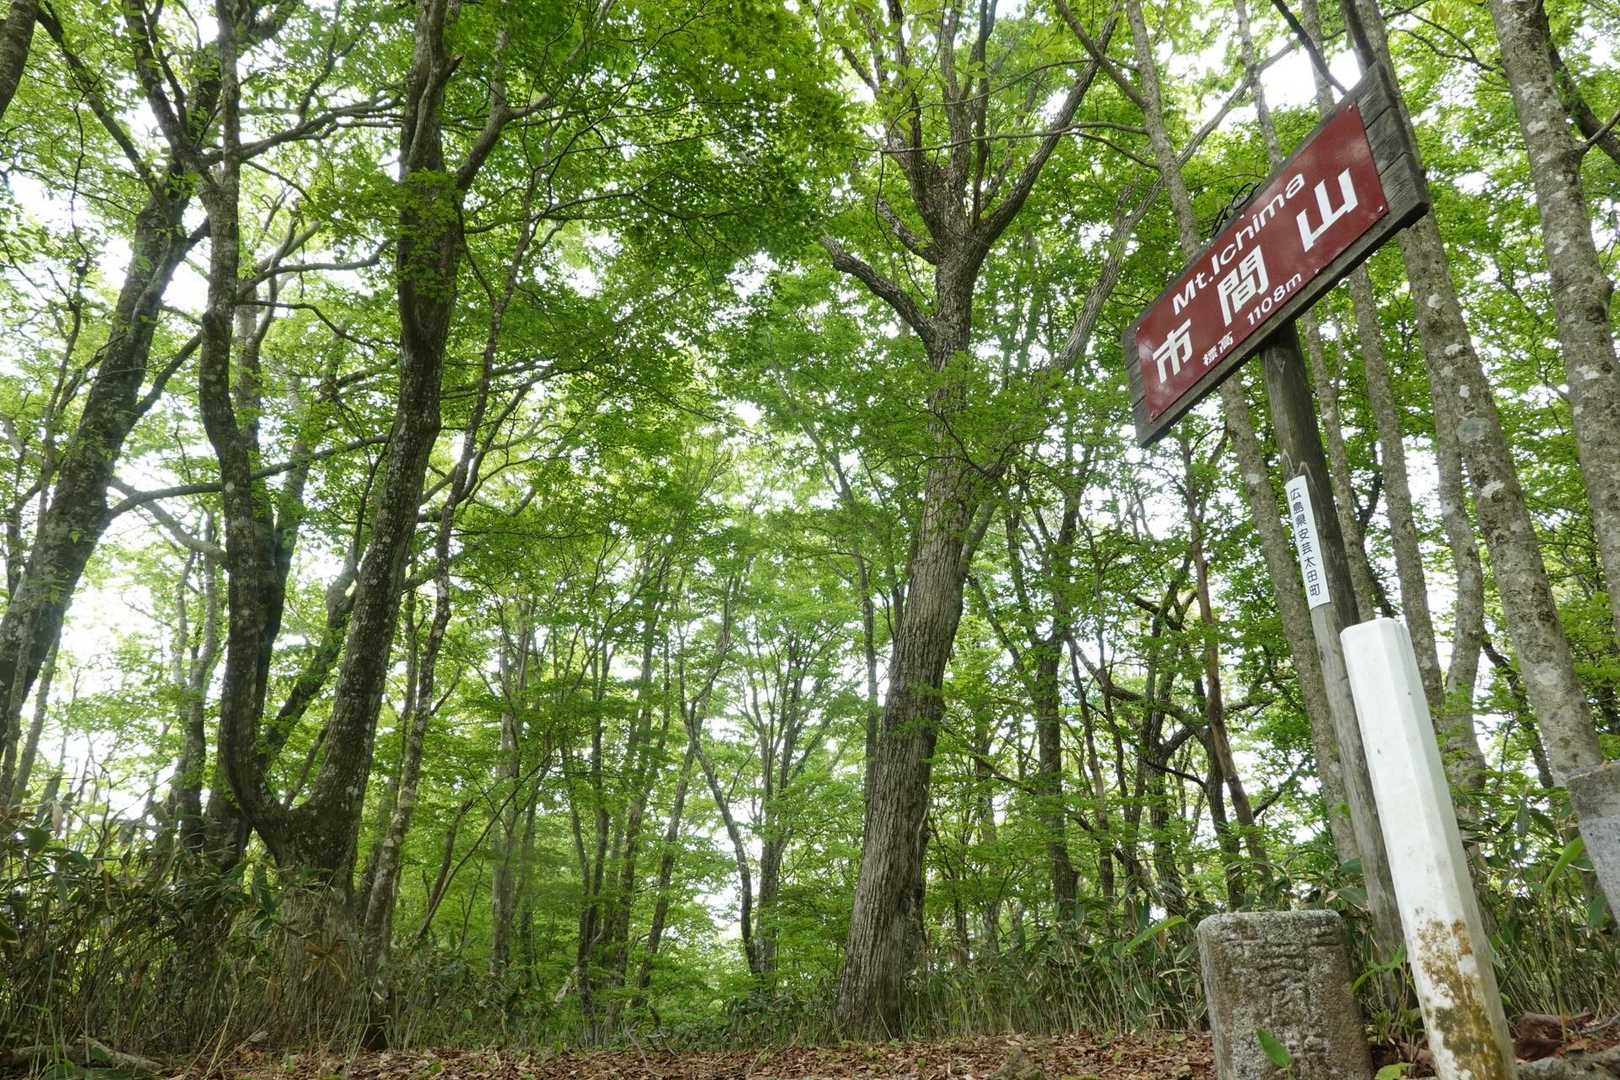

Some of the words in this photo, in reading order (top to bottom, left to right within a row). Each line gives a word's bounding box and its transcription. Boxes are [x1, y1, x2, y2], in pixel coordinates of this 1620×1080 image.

[1153, 168, 1358, 384] 市間山
[1203, 332, 1234, 366] 標高
[1247, 273, 1302, 325] 1108m
[1290, 488, 1321, 597] 広島県安芸太田町
